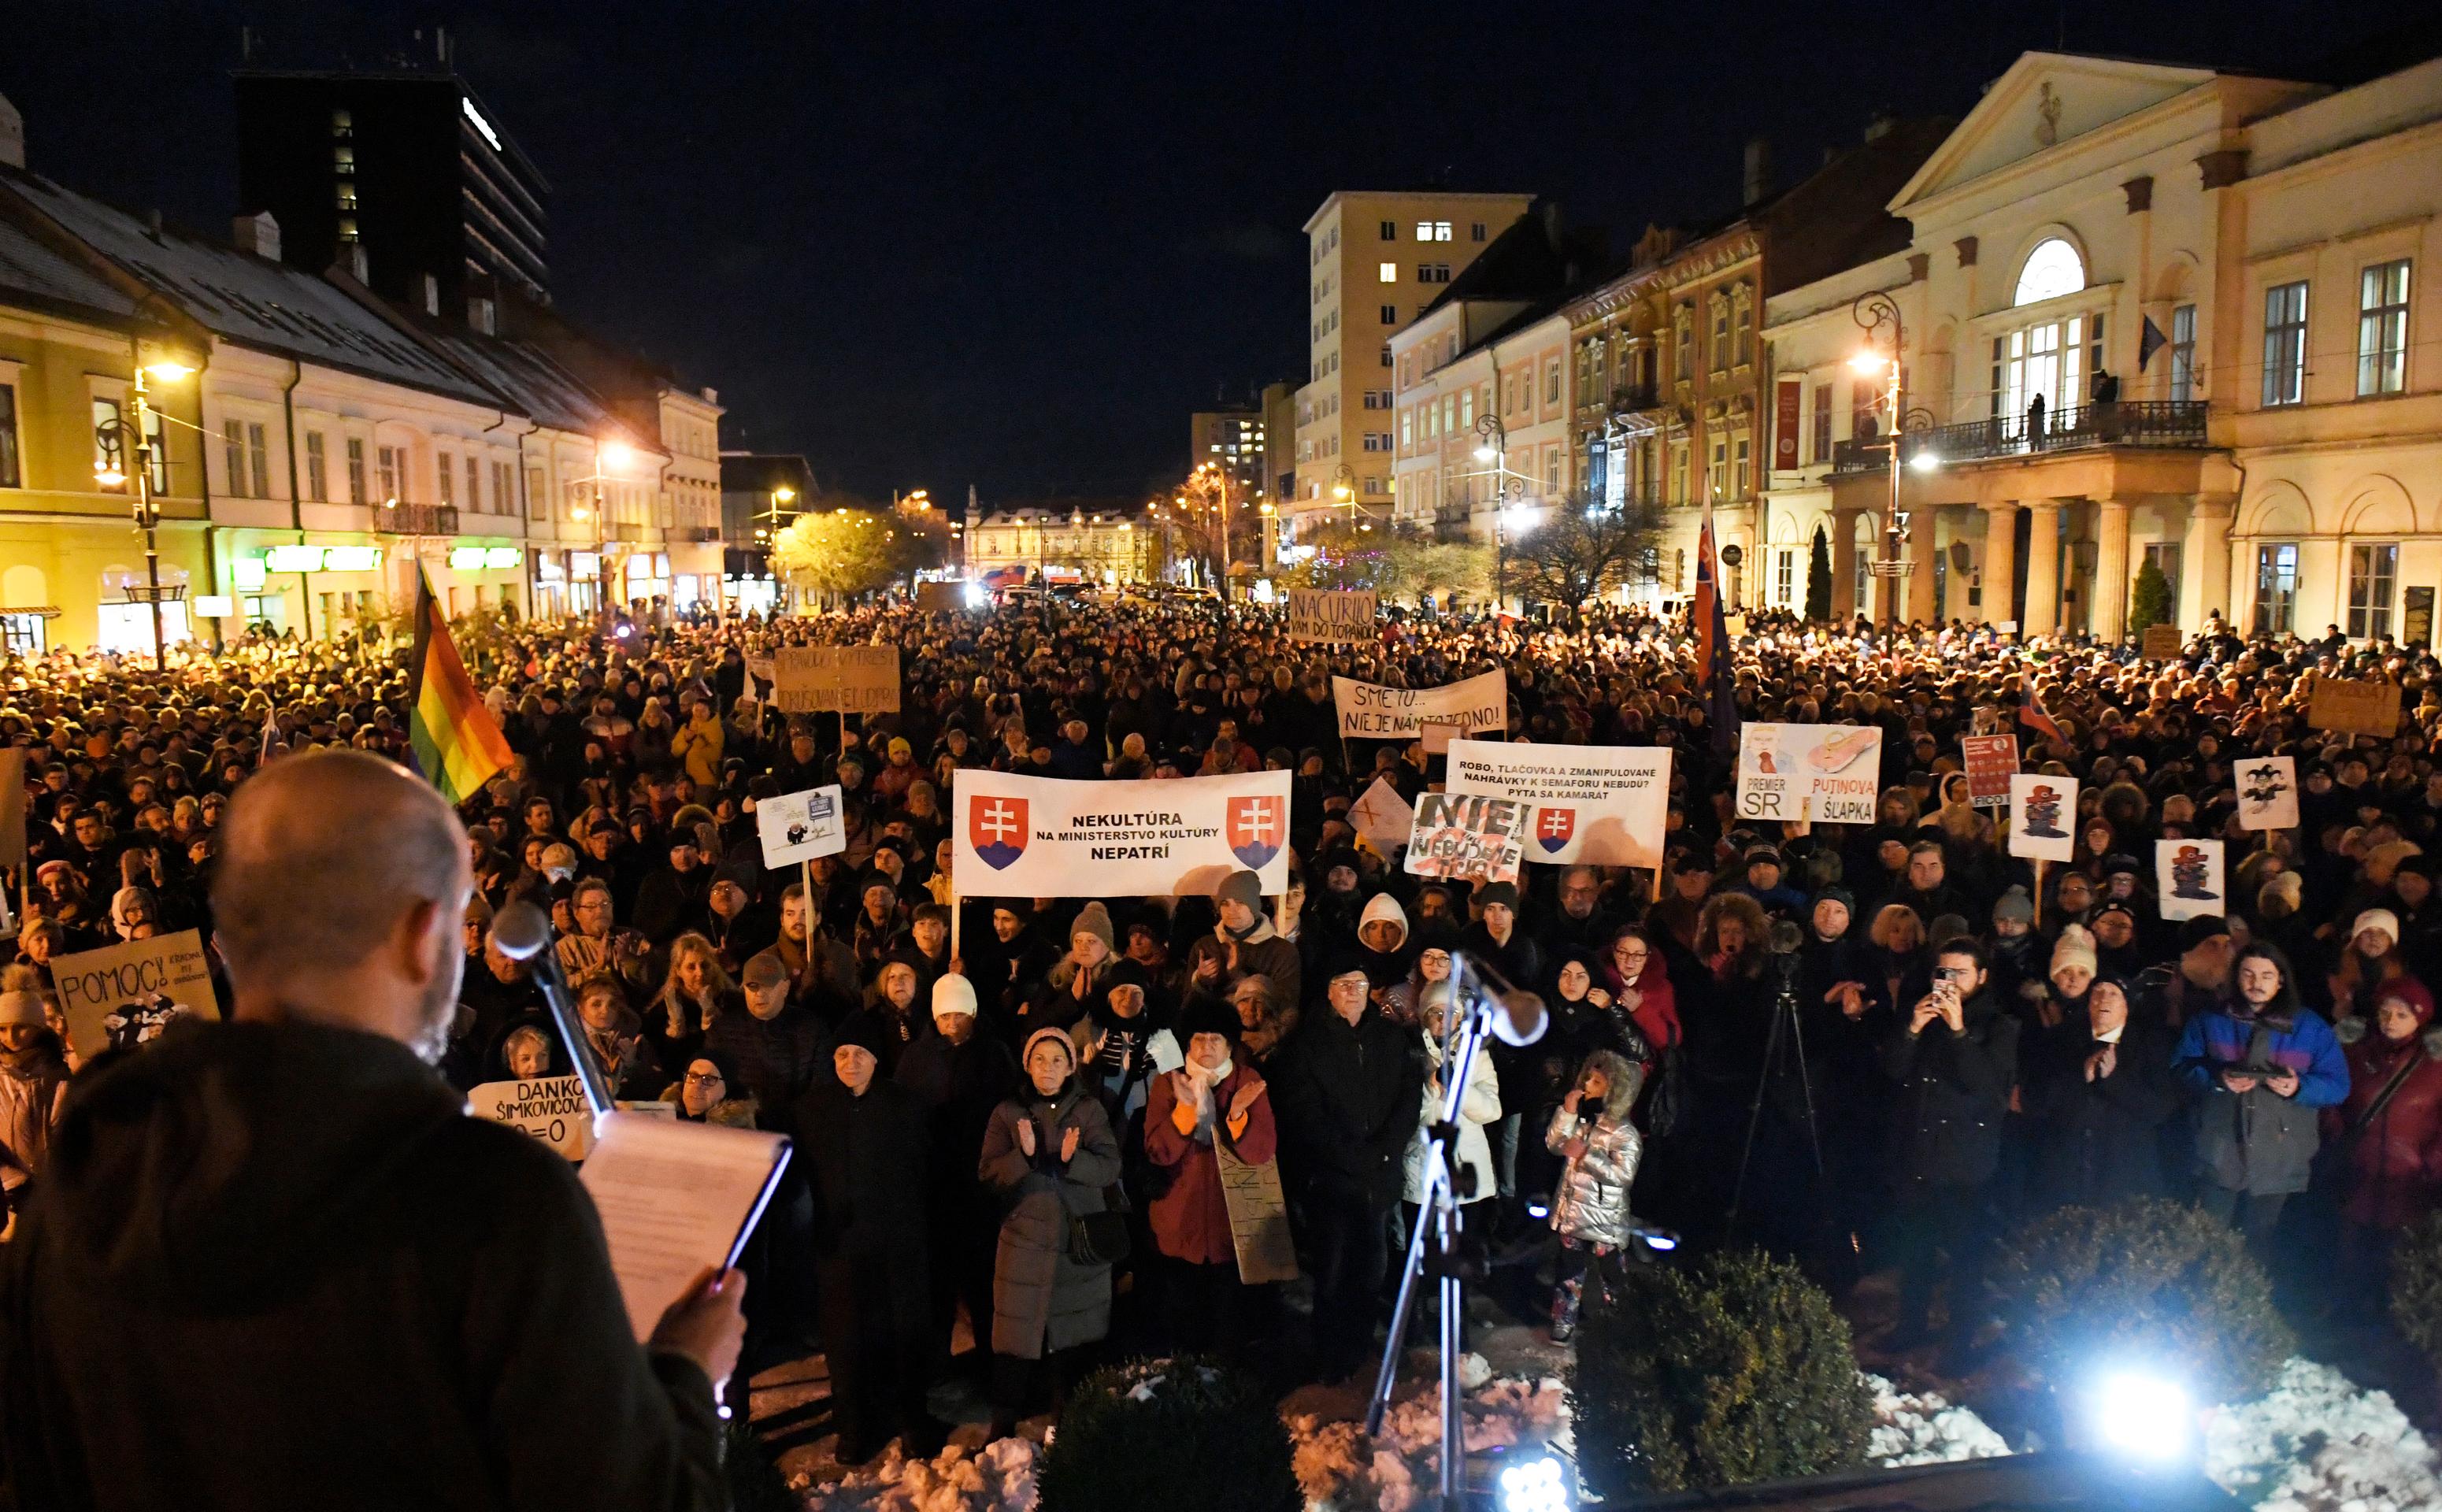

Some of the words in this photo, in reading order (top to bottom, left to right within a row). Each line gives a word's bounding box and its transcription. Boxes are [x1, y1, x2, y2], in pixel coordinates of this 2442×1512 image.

[1314, 622, 1329, 637] DO
[1354, 685, 1393, 708] SME
[1345, 712, 1373, 732] NIE
[1375, 714, 1390, 732] JE
[1459, 761, 1494, 773] ROBO,
[1498, 764, 1556, 775] TLAČOVKA
[1569, 766, 1657, 777] ZMANIPULOVANÉ
[1464, 773, 1527, 785] NAHRÁVKY
[1541, 778, 1600, 788] SEMAFORU
[1603, 778, 1650, 788] NEBUDÚ?
[1747, 775, 1786, 791] PREMIÉR
[1811, 778, 1877, 795] PUTINOVA
[1507, 788, 1536, 797] PÝTA
[1540, 790, 1554, 799] SA
[1557, 790, 1609, 800] KAMARÁT
[1974, 795, 2004, 805] FICO
[1743, 792, 1781, 817] SR
[1823, 796, 1872, 820] ŠĽAPKA
[1073, 810, 1183, 828] NEKULTÚRA
[1417, 794, 1532, 844] NIE!
[1036, 831, 1054, 840] NA
[1058, 831, 1155, 841] MINISTERSTVO
[1160, 827, 1219, 839] KULTÚRY
[1091, 843, 1169, 860] NEPATRÍ
[61, 955, 168, 1009] POMOC!
[517, 1078, 584, 1101] DANKO
